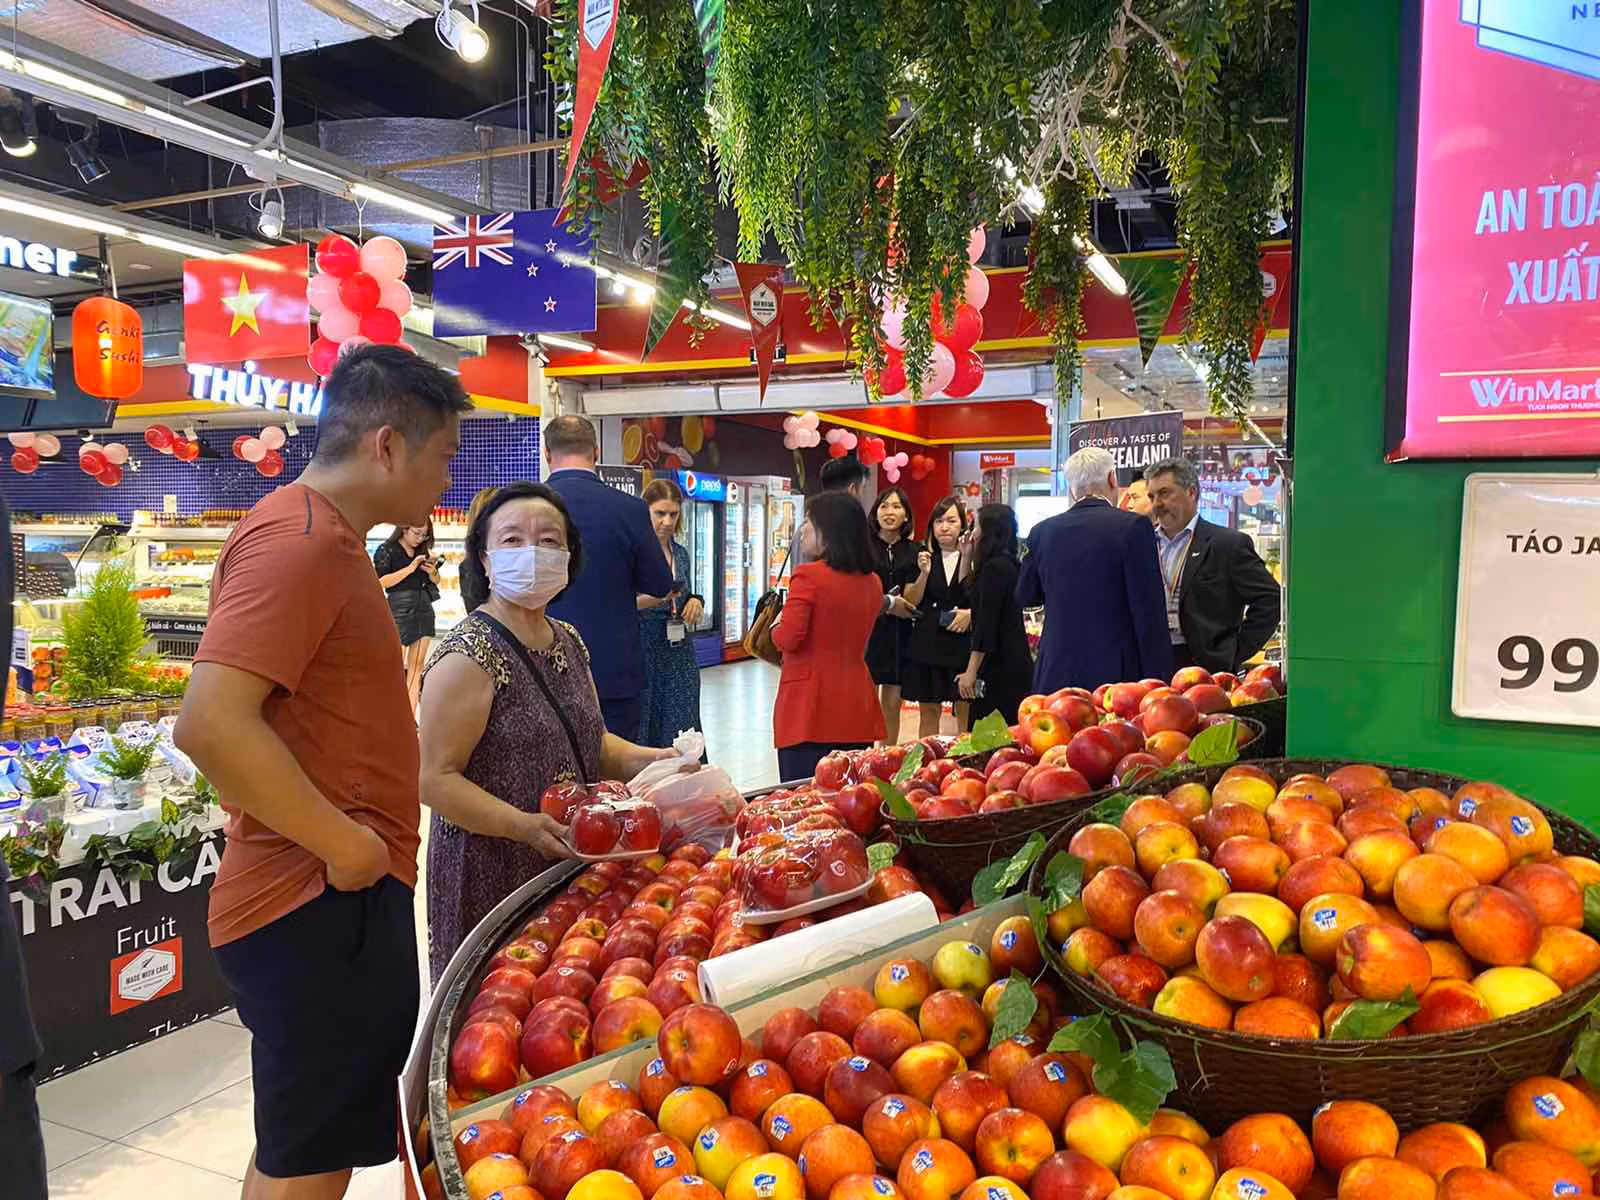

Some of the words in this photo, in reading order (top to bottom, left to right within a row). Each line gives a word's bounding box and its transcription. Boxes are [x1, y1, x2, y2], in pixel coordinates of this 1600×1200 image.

[1474, 187, 1528, 235] AN
[0, 236, 77, 277] ner
[1504, 241, 1600, 304] XUẤT
[187, 360, 285, 411] THỦY
[1470, 377, 1600, 408] WinMart
[1080, 437, 1119, 448] DISCOVER
[1120, 436, 1128, 445] A
[1130, 434, 1156, 443] TASTE
[1158, 432, 1171, 442] OF
[1506, 529, 1563, 554] TÁO
[1571, 536, 1600, 555] JA
[1497, 635, 1600, 692] 99
[117, 916, 177, 955] Fruit
